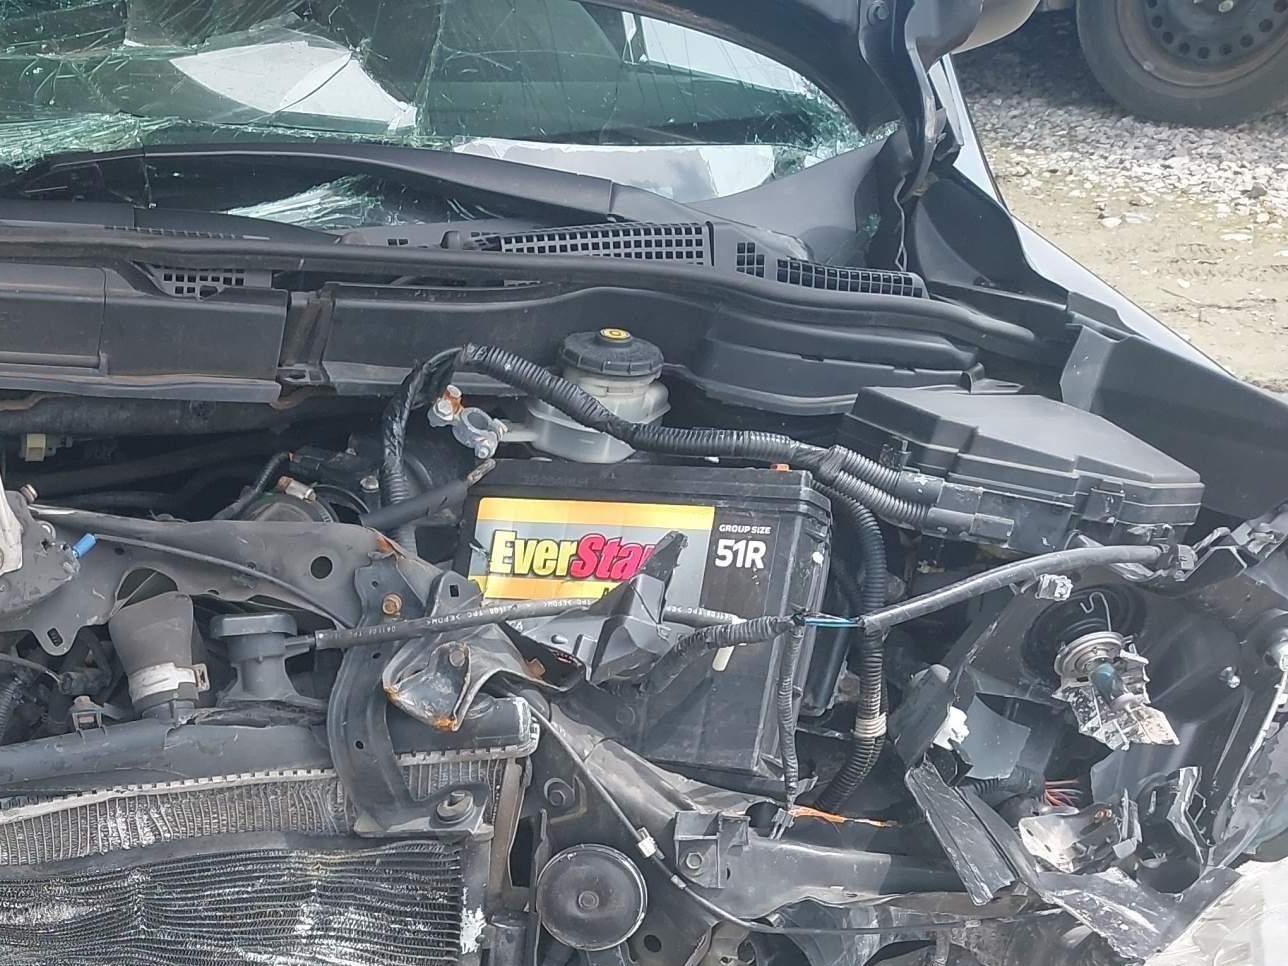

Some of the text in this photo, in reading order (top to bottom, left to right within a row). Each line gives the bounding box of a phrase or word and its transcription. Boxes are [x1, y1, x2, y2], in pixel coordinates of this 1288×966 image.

[718, 524, 772, 535] GROUP SIZE
[489, 528, 656, 581] EverSta
[714, 538, 767, 569] 51R
